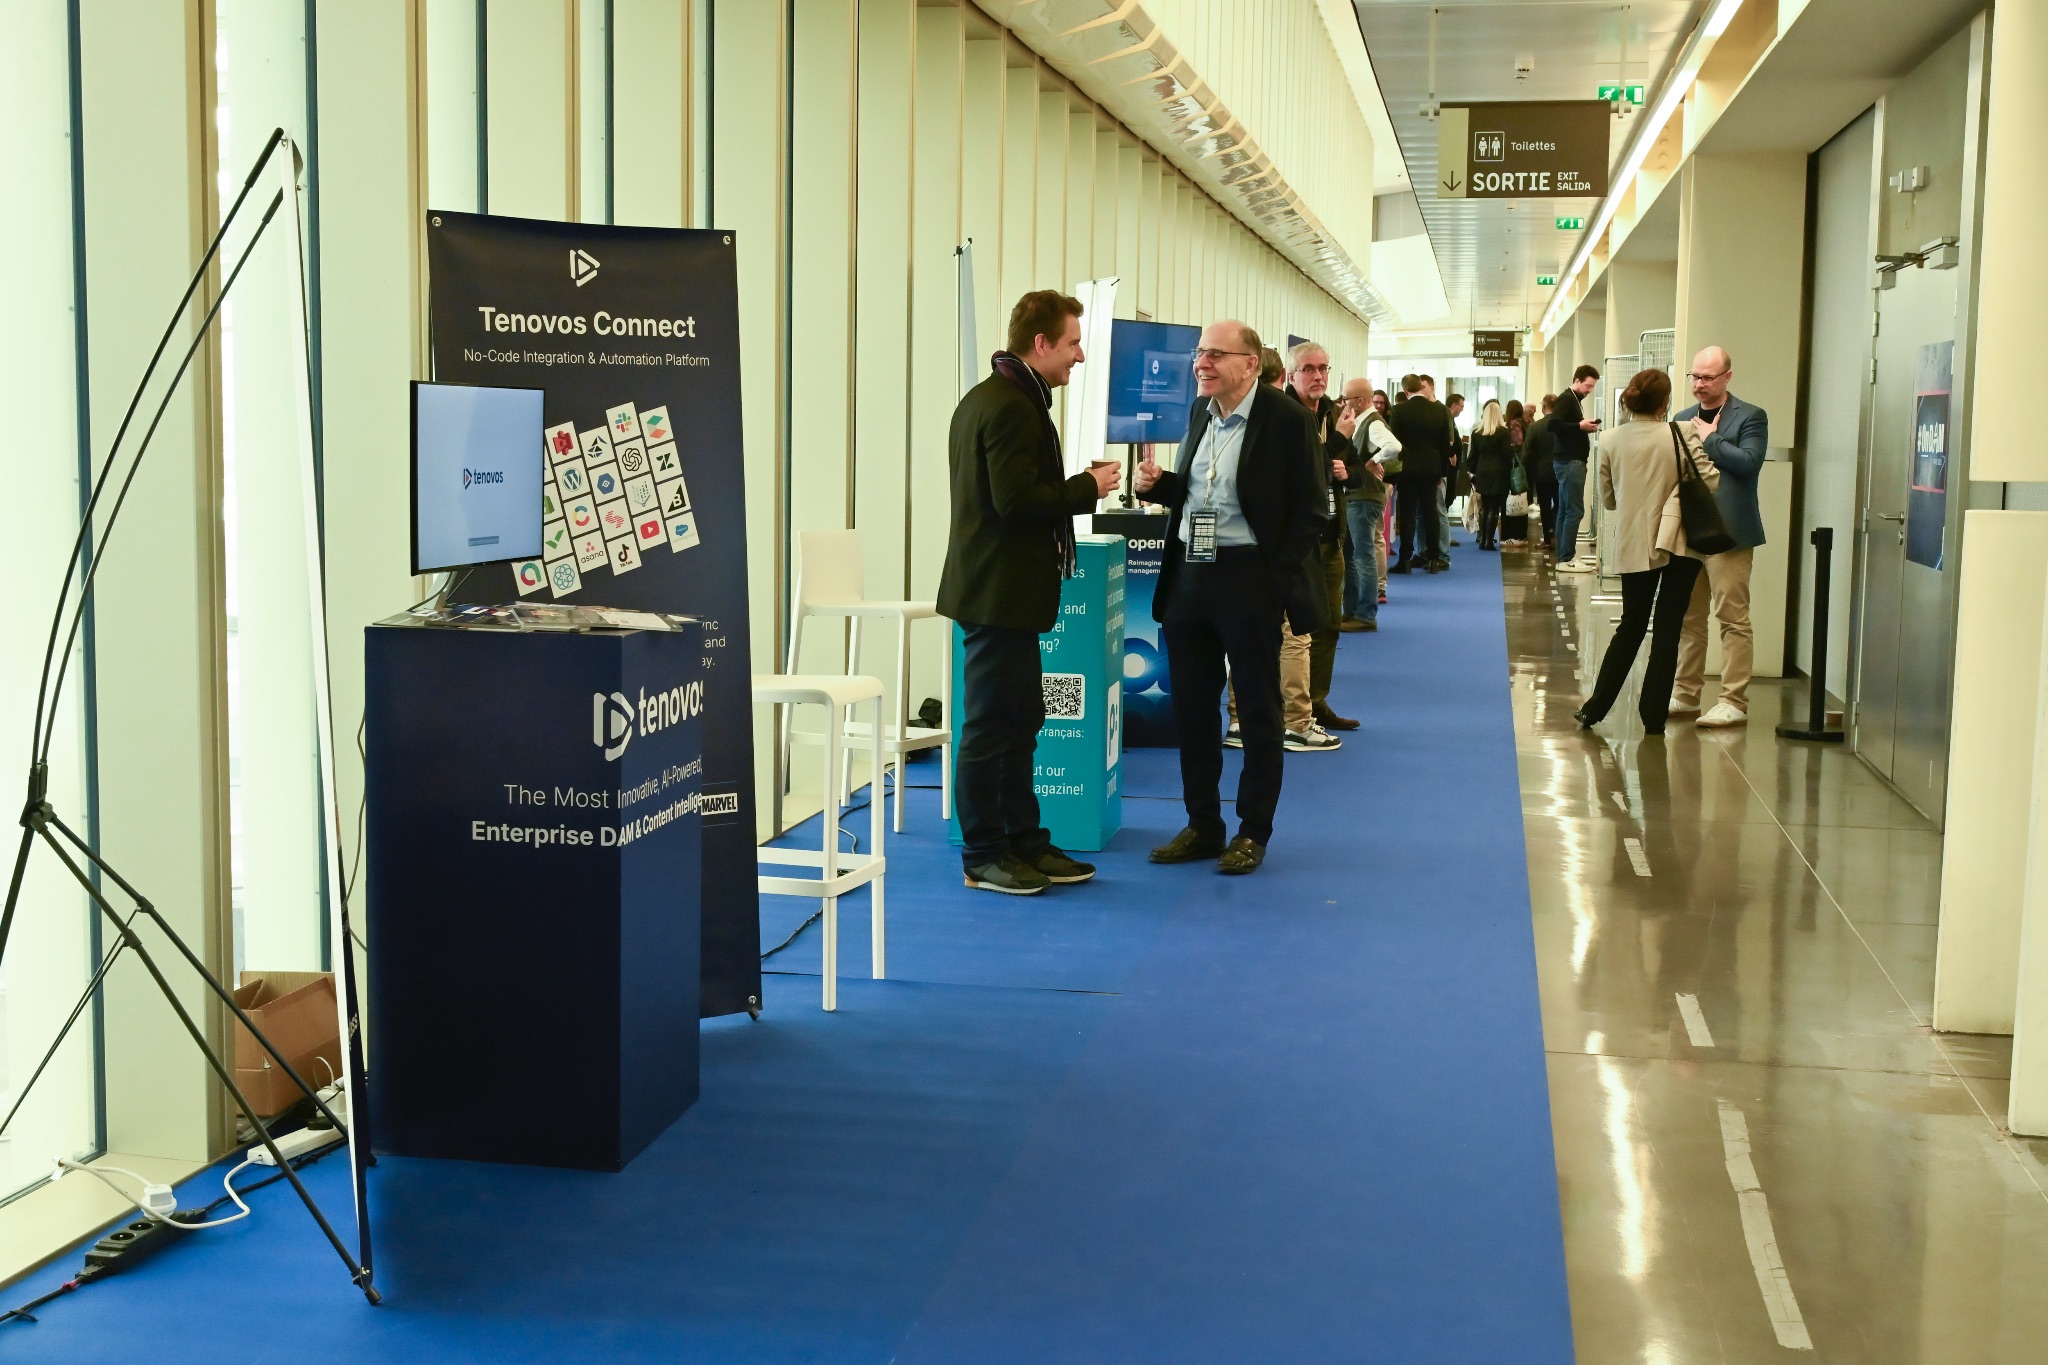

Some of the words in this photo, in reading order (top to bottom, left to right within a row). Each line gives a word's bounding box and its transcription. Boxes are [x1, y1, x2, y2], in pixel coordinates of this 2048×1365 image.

[1511, 140, 1556, 151] Toilettes
[1472, 172, 1551, 192] SORTIE
[1557, 171, 1579, 181] EXIT
[1557, 182, 1591, 191] SALIDA
[479, 306, 587, 335] Tenovos
[594, 311, 696, 338] Connect
[464, 349, 520, 363] No-Code
[523, 350, 585, 366] Integration
[588, 352, 596, 364] &
[599, 352, 662, 366] Automation
[666, 353, 710, 367] Platform
[473, 468, 504, 485] tenovos
[580, 550, 605, 564] asana
[1064, 602, 1086, 615] and
[704, 635, 726, 649] and
[1039, 638, 1060, 653] ng?
[1033, 764, 1043, 776] ut
[1046, 766, 1066, 777] our
[504, 784, 546, 806] The
[554, 785, 609, 809] Most
[617, 777, 660, 809] Innovative,
[661, 754, 703, 789] AI-Powered,
[1034, 783, 1084, 797] agazine!
[702, 794, 737, 814] MARVEL
[472, 820, 594, 848] Enterprise
[600, 821, 634, 848] DAM
[635, 818, 642, 839] &
[643, 802, 674, 835] Content
